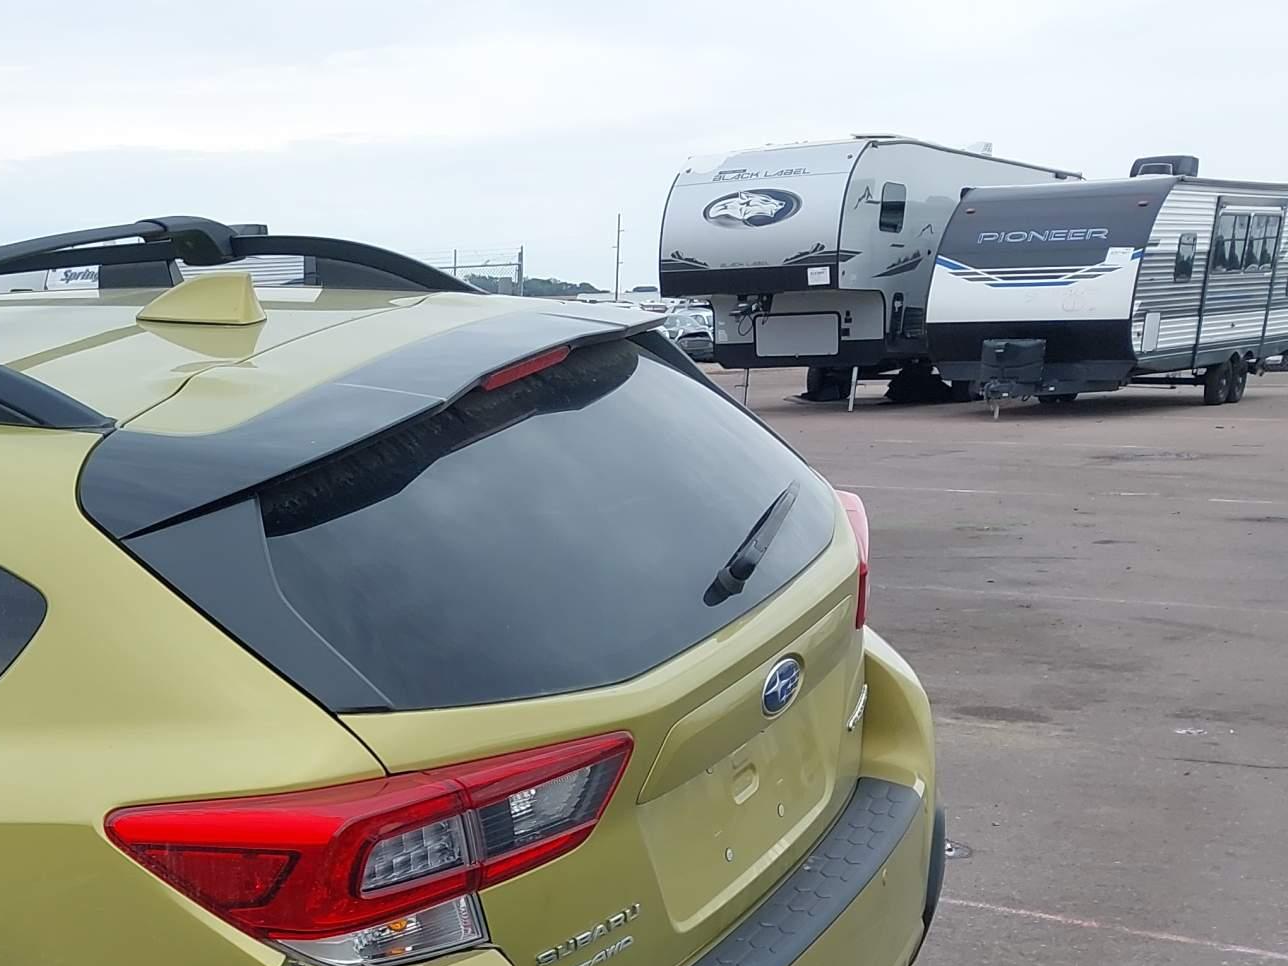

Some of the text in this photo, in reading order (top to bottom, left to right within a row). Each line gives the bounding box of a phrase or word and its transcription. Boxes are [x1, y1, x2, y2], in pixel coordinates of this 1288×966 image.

[712, 171, 759, 182] BLACK
[764, 167, 810, 177] LABEL
[977, 228, 1109, 244] PIONEER
